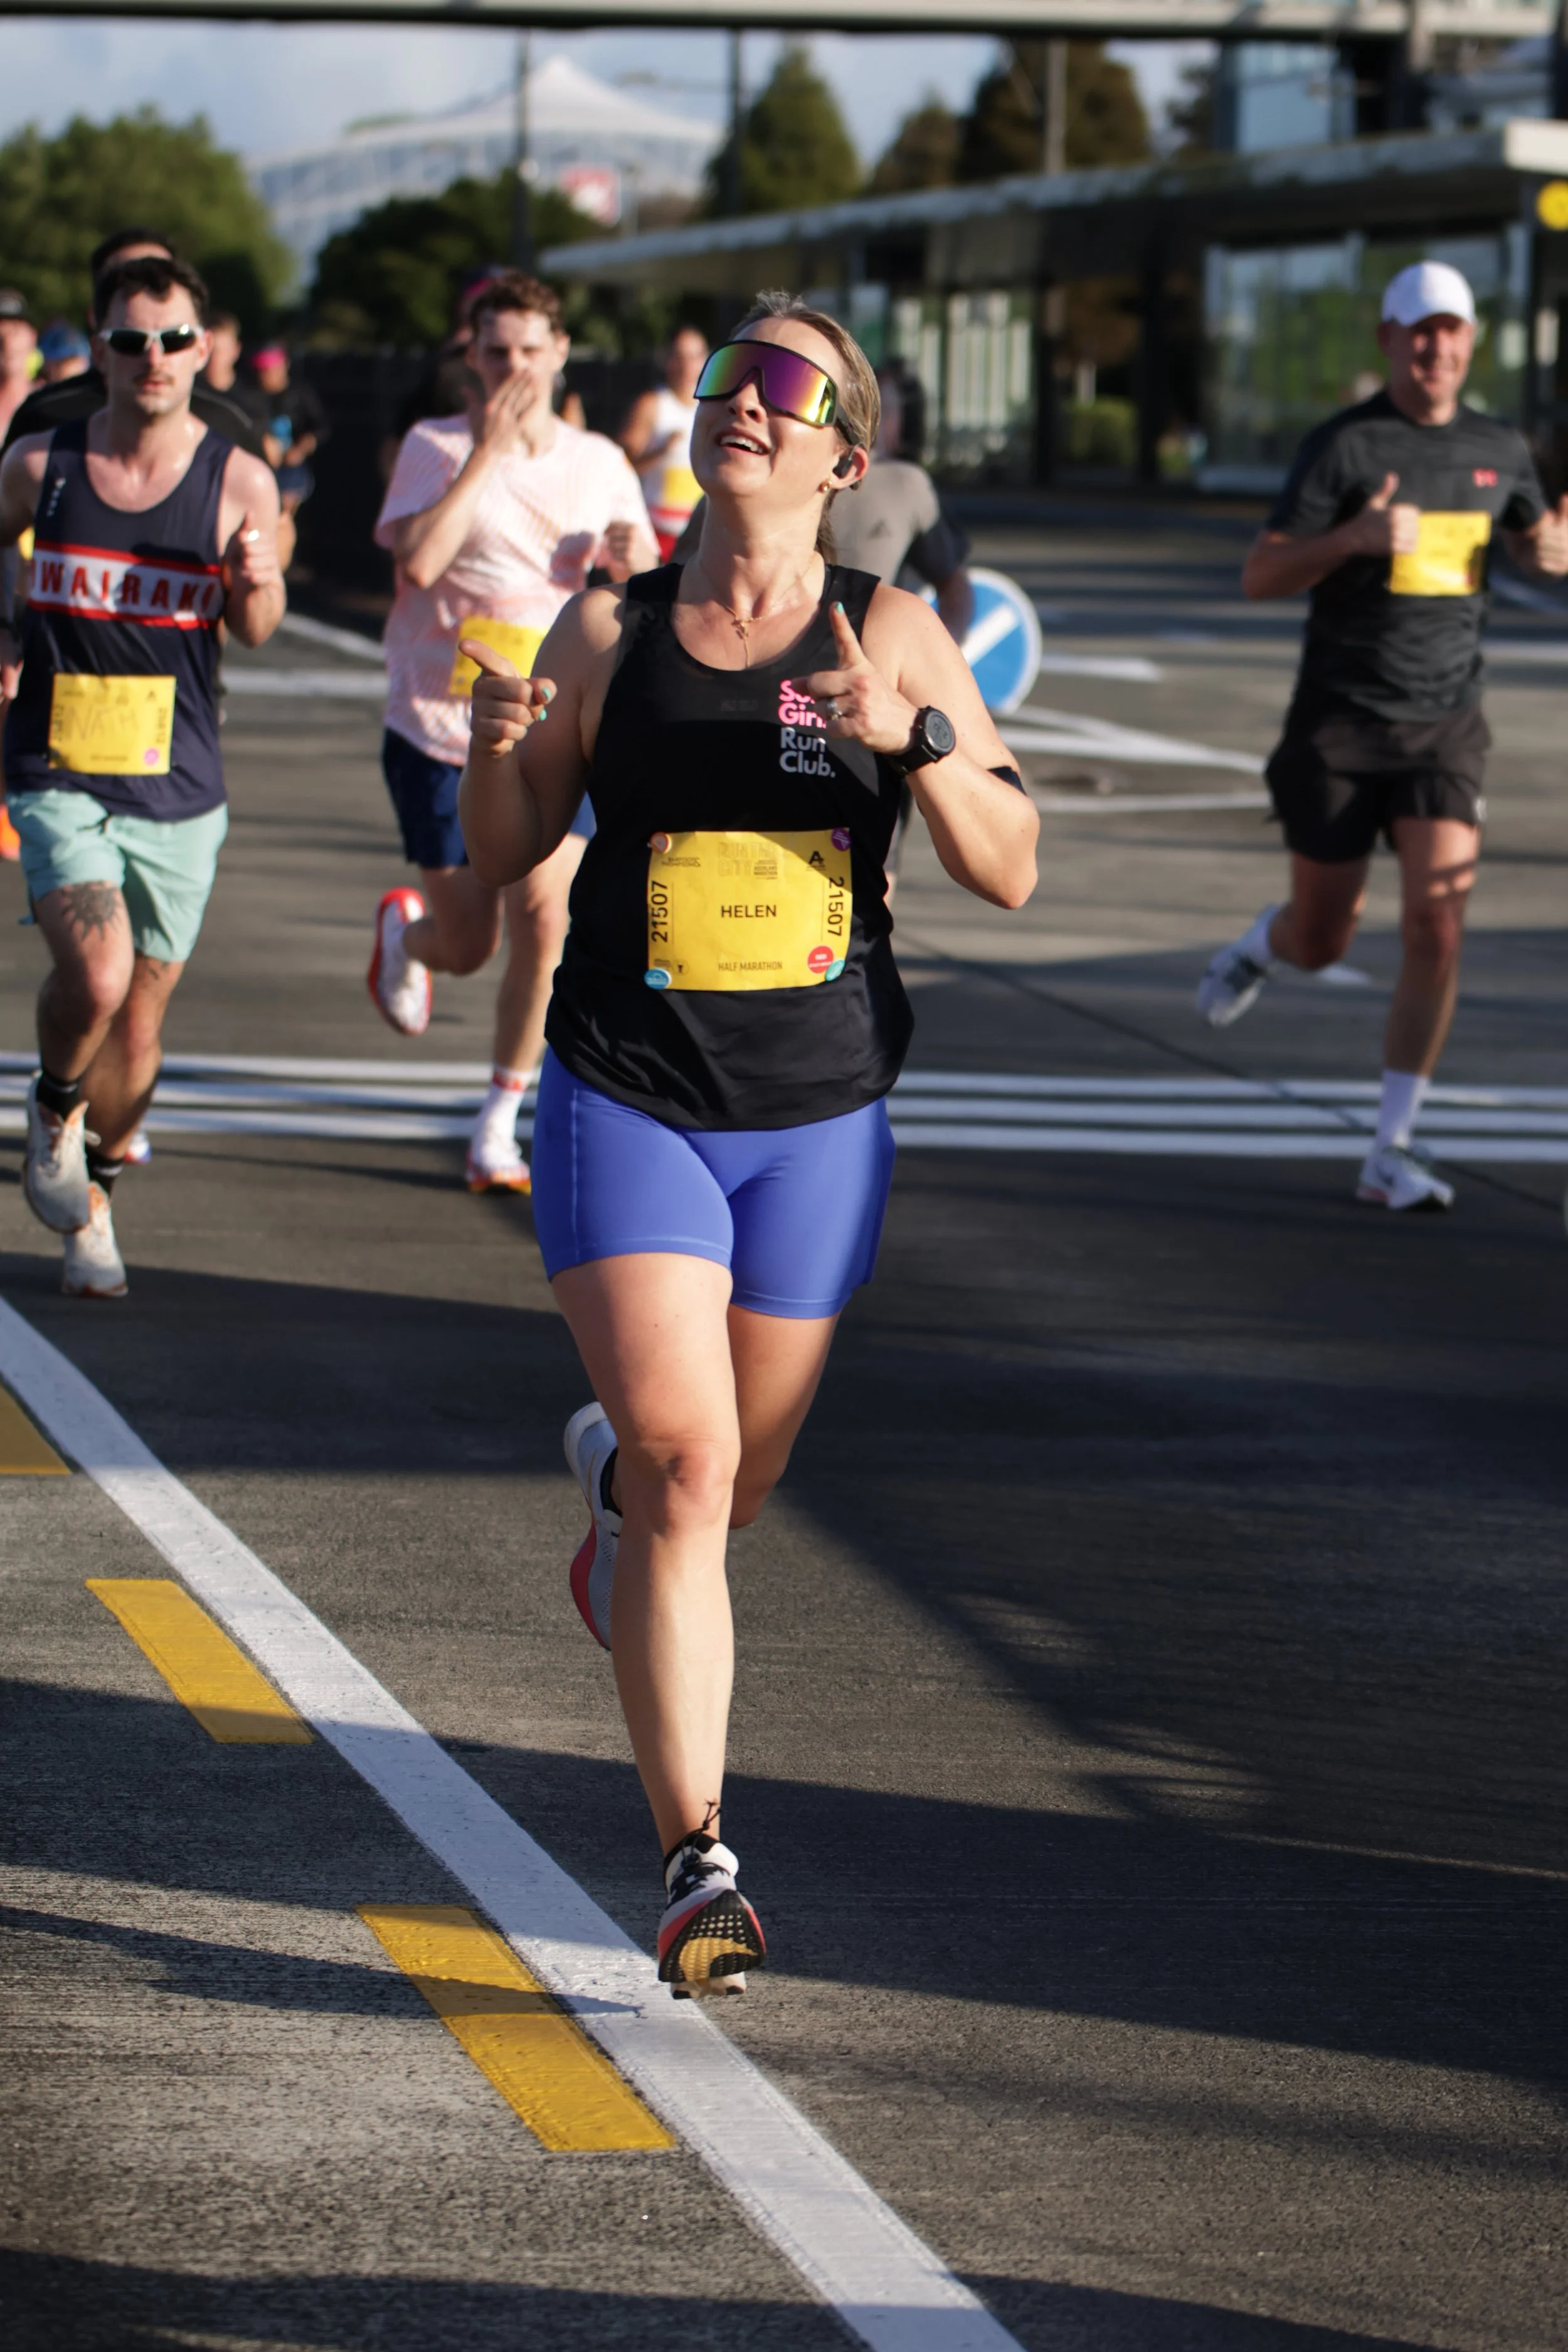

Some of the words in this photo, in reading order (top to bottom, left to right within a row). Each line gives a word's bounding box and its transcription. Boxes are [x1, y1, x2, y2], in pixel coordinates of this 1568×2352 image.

[780, 727, 826, 752] Run
[780, 751, 836, 778] Club.
[651, 881, 669, 943] 21507
[721, 904, 777, 918] HELEN
[827, 876, 845, 936] 21507
[718, 962, 737, 972] HALF
[739, 961, 783, 972] MARATHON
